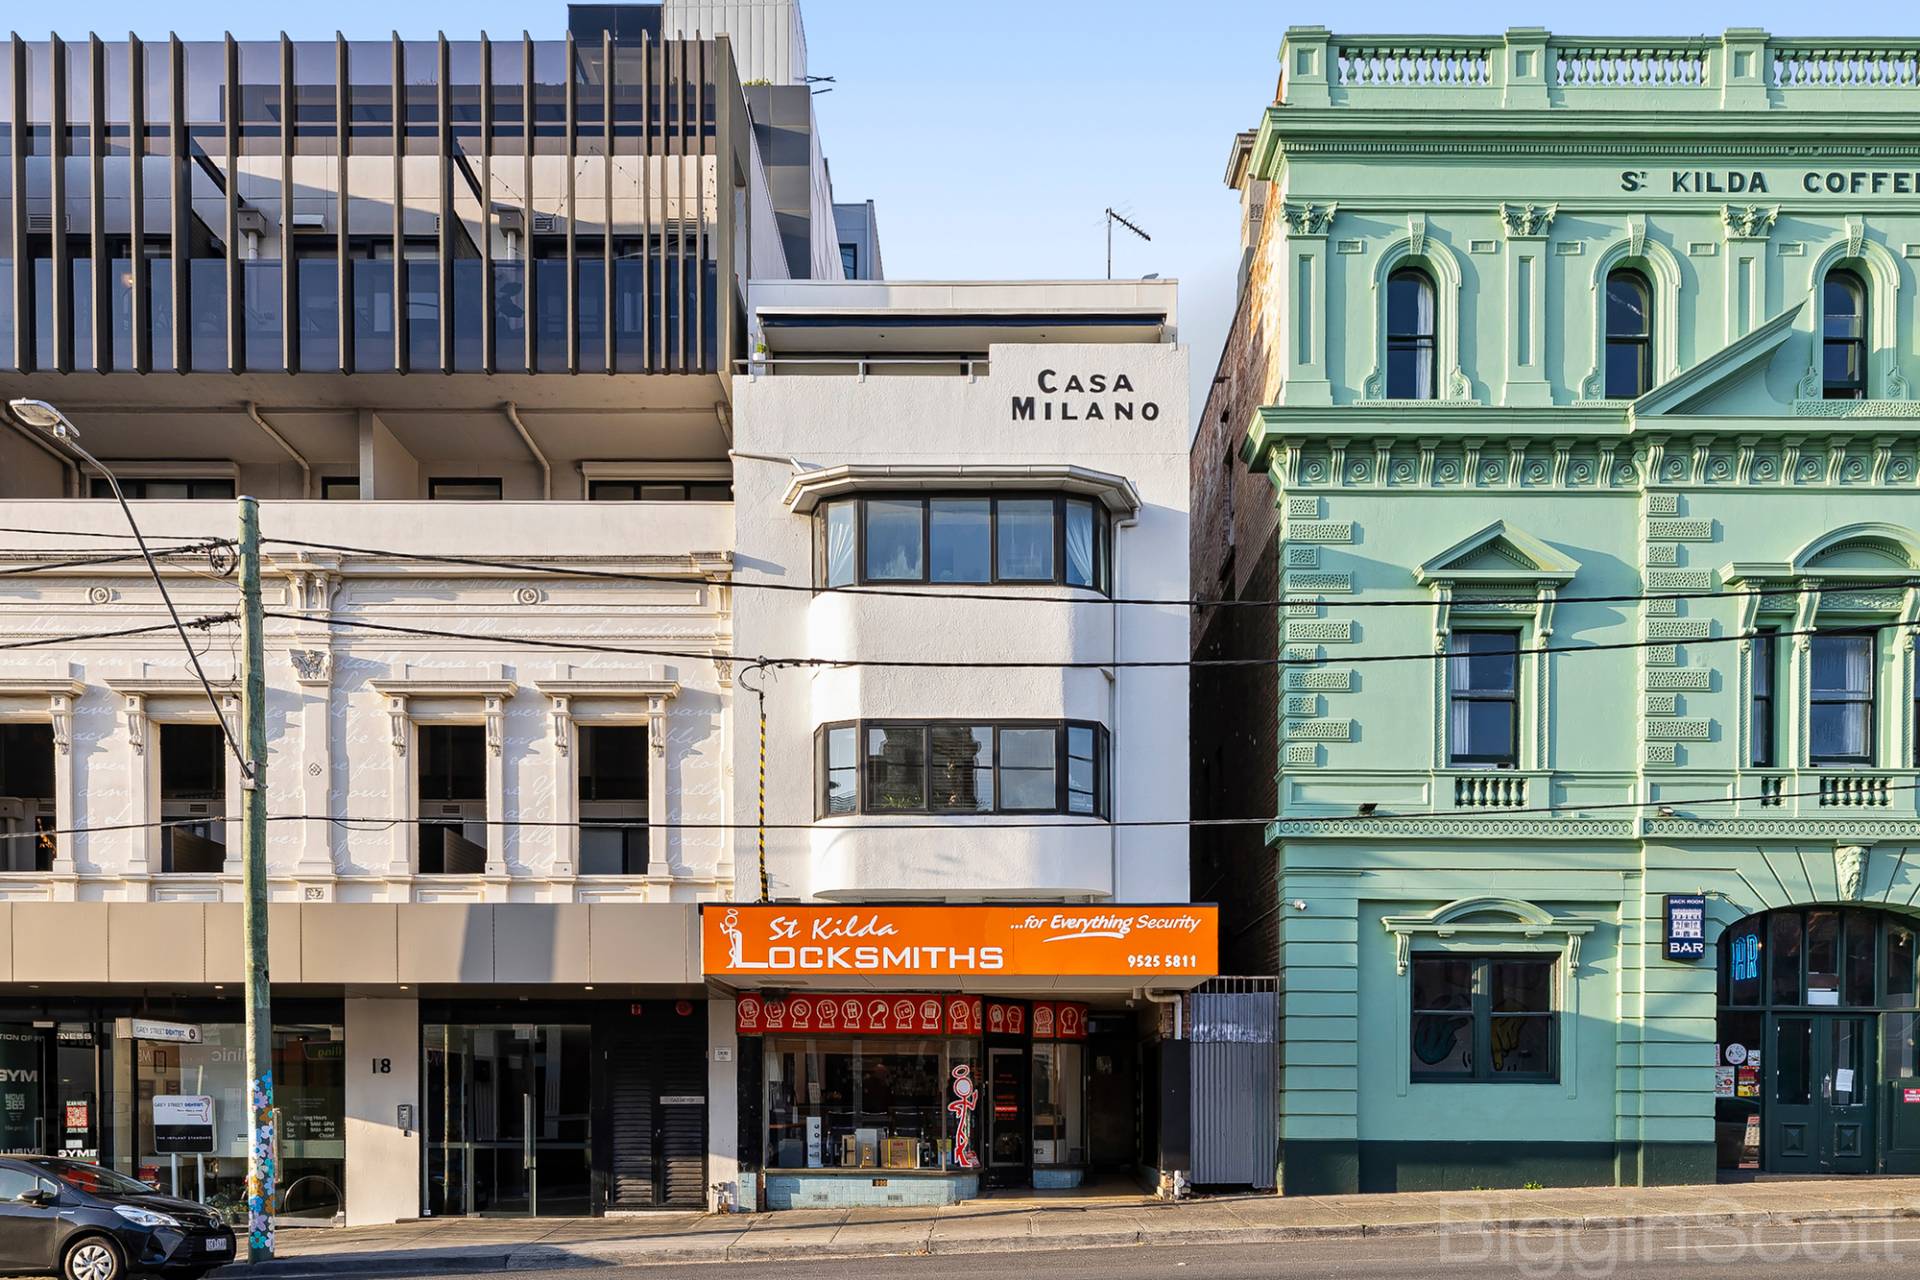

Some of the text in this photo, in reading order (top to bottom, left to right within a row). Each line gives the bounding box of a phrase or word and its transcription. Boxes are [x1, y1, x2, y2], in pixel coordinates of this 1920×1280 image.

[1672, 171, 1769, 193] KILDA
[1037, 369, 1134, 393] CASA
[1012, 396, 1160, 421] MILANO
[768, 914, 900, 941] St Kilda
[1050, 914, 1134, 934] Everything
[1136, 914, 1201, 933] Security
[732, 929, 1004, 969] LOCKSMITHS
[1670, 942, 1704, 953] BAR
[1127, 954, 1197, 968] 9525 5811
[372, 1058, 391, 1074] 18
